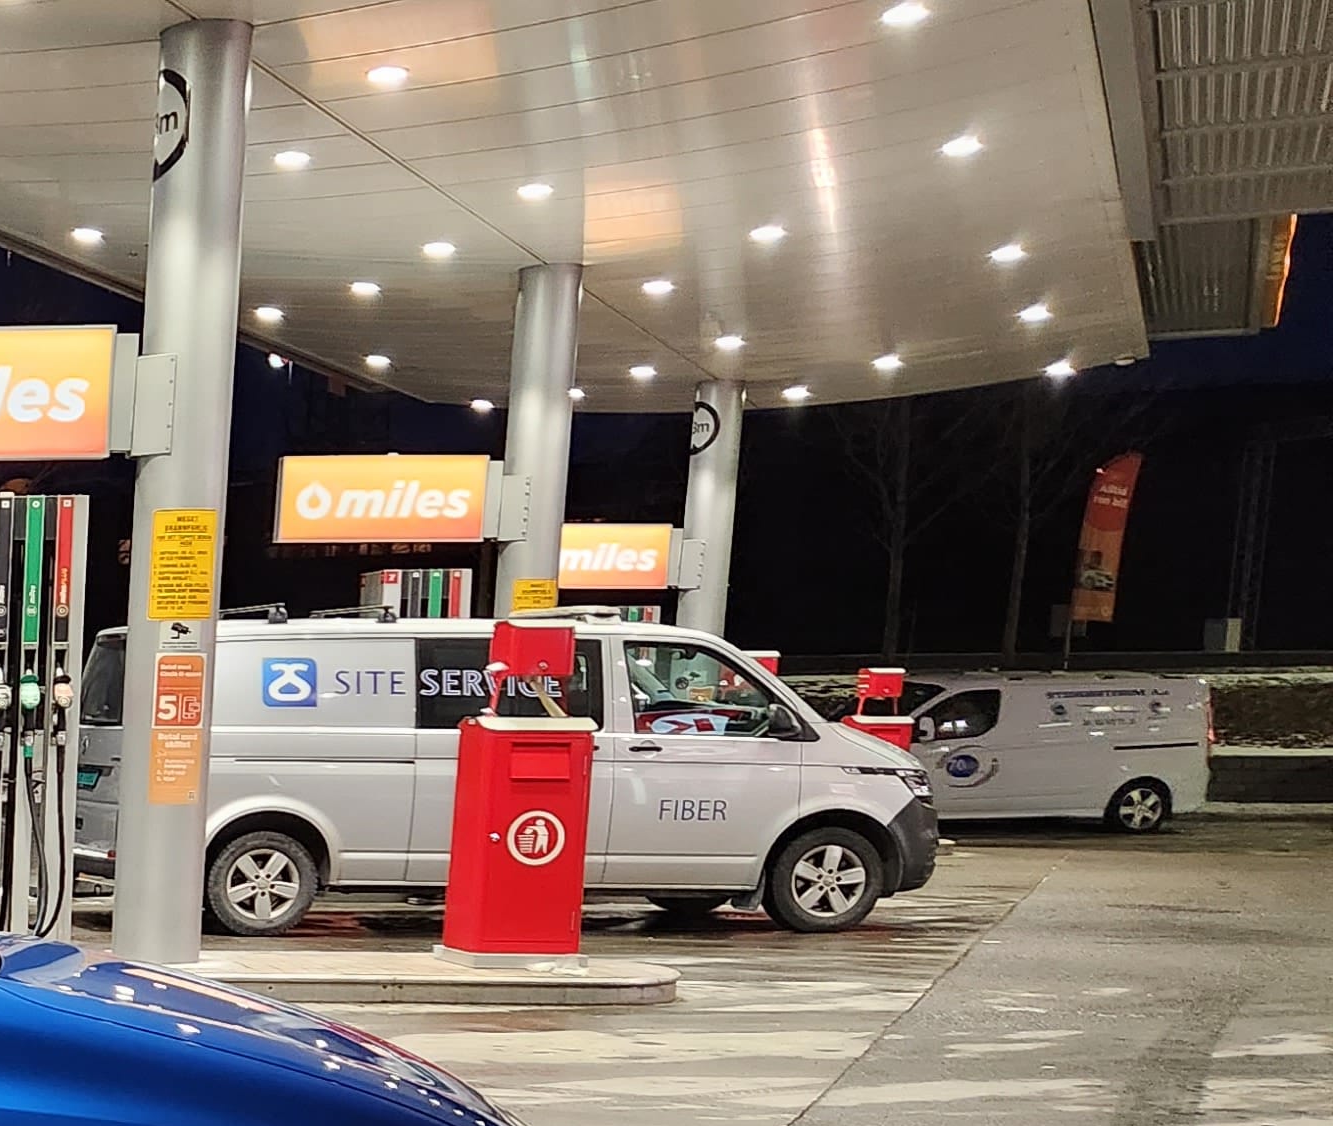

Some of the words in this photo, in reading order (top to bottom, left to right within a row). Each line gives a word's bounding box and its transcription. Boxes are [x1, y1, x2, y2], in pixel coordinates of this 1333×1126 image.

[335, 481, 472, 519] miles
[558, 542, 658, 572] miles
[333, 670, 407, 695] SITE
[157, 695, 178, 721] 5
[658, 799, 728, 822] FIBER
